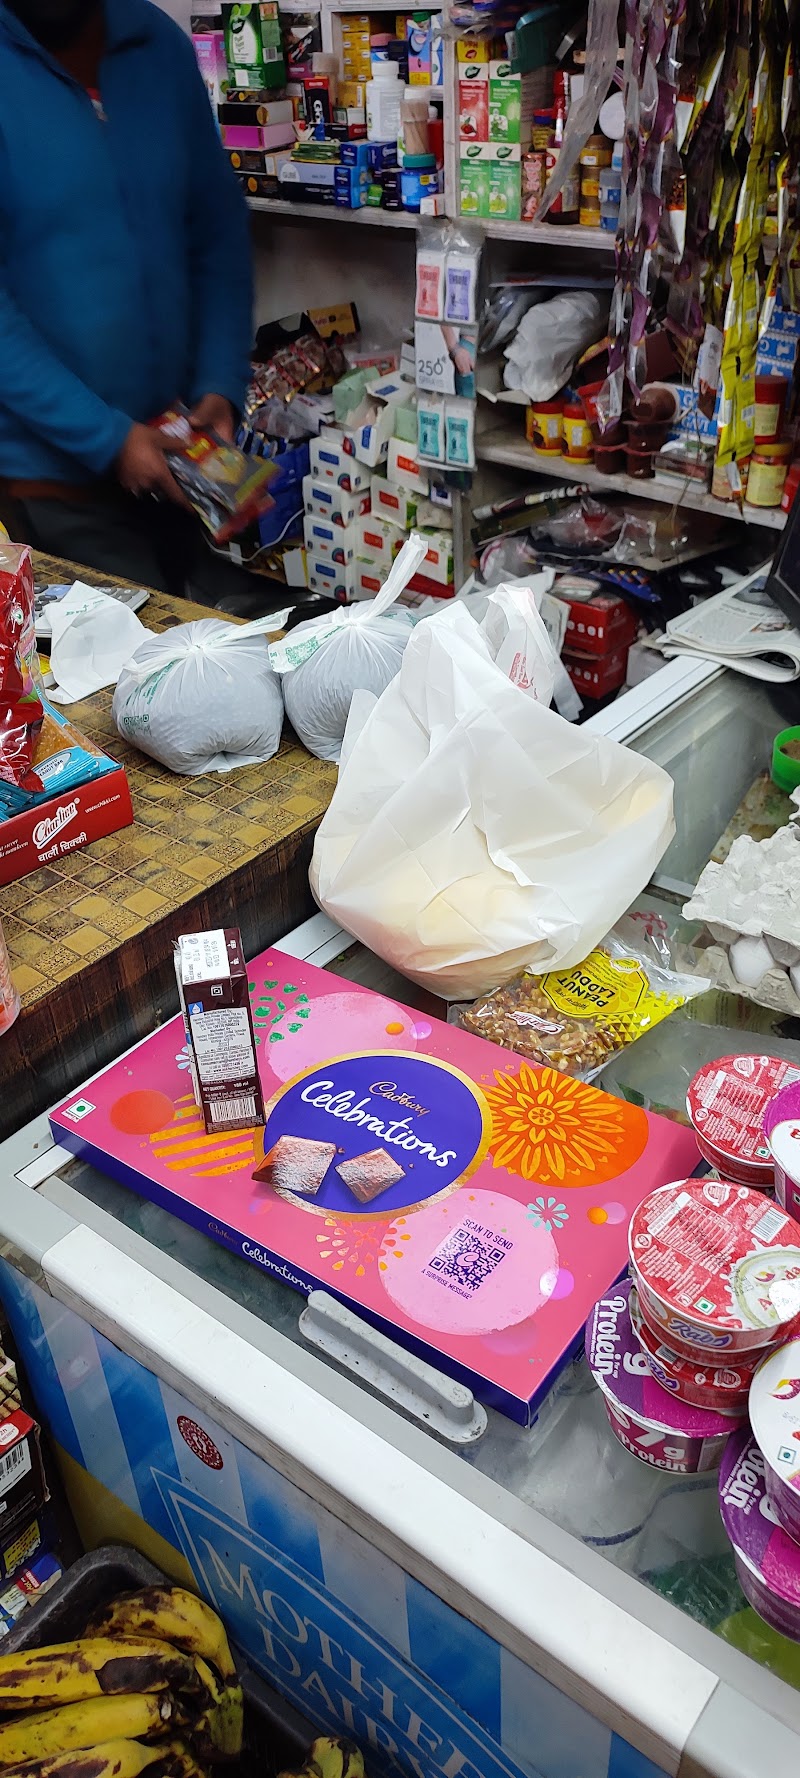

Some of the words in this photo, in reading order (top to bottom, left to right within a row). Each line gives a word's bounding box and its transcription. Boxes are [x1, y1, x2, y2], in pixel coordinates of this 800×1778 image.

[557, 978, 609, 1008] PEANUT
[571, 970, 615, 999] LADDU
[369, 1081, 430, 1117] Cadbury
[301, 1080, 456, 1167] Celebrations
[208, 1221, 239, 1246] Cadbury
[462, 1219, 484, 1234] SCAN
[483, 1229, 493, 1239] TO
[492, 1234, 514, 1250] SEND
[241, 1241, 314, 1293] Celebrations
[426, 1270, 448, 1287] SURPRISE
[594, 1295, 627, 1376] Protein
[618, 1428, 688, 1472] Protein
